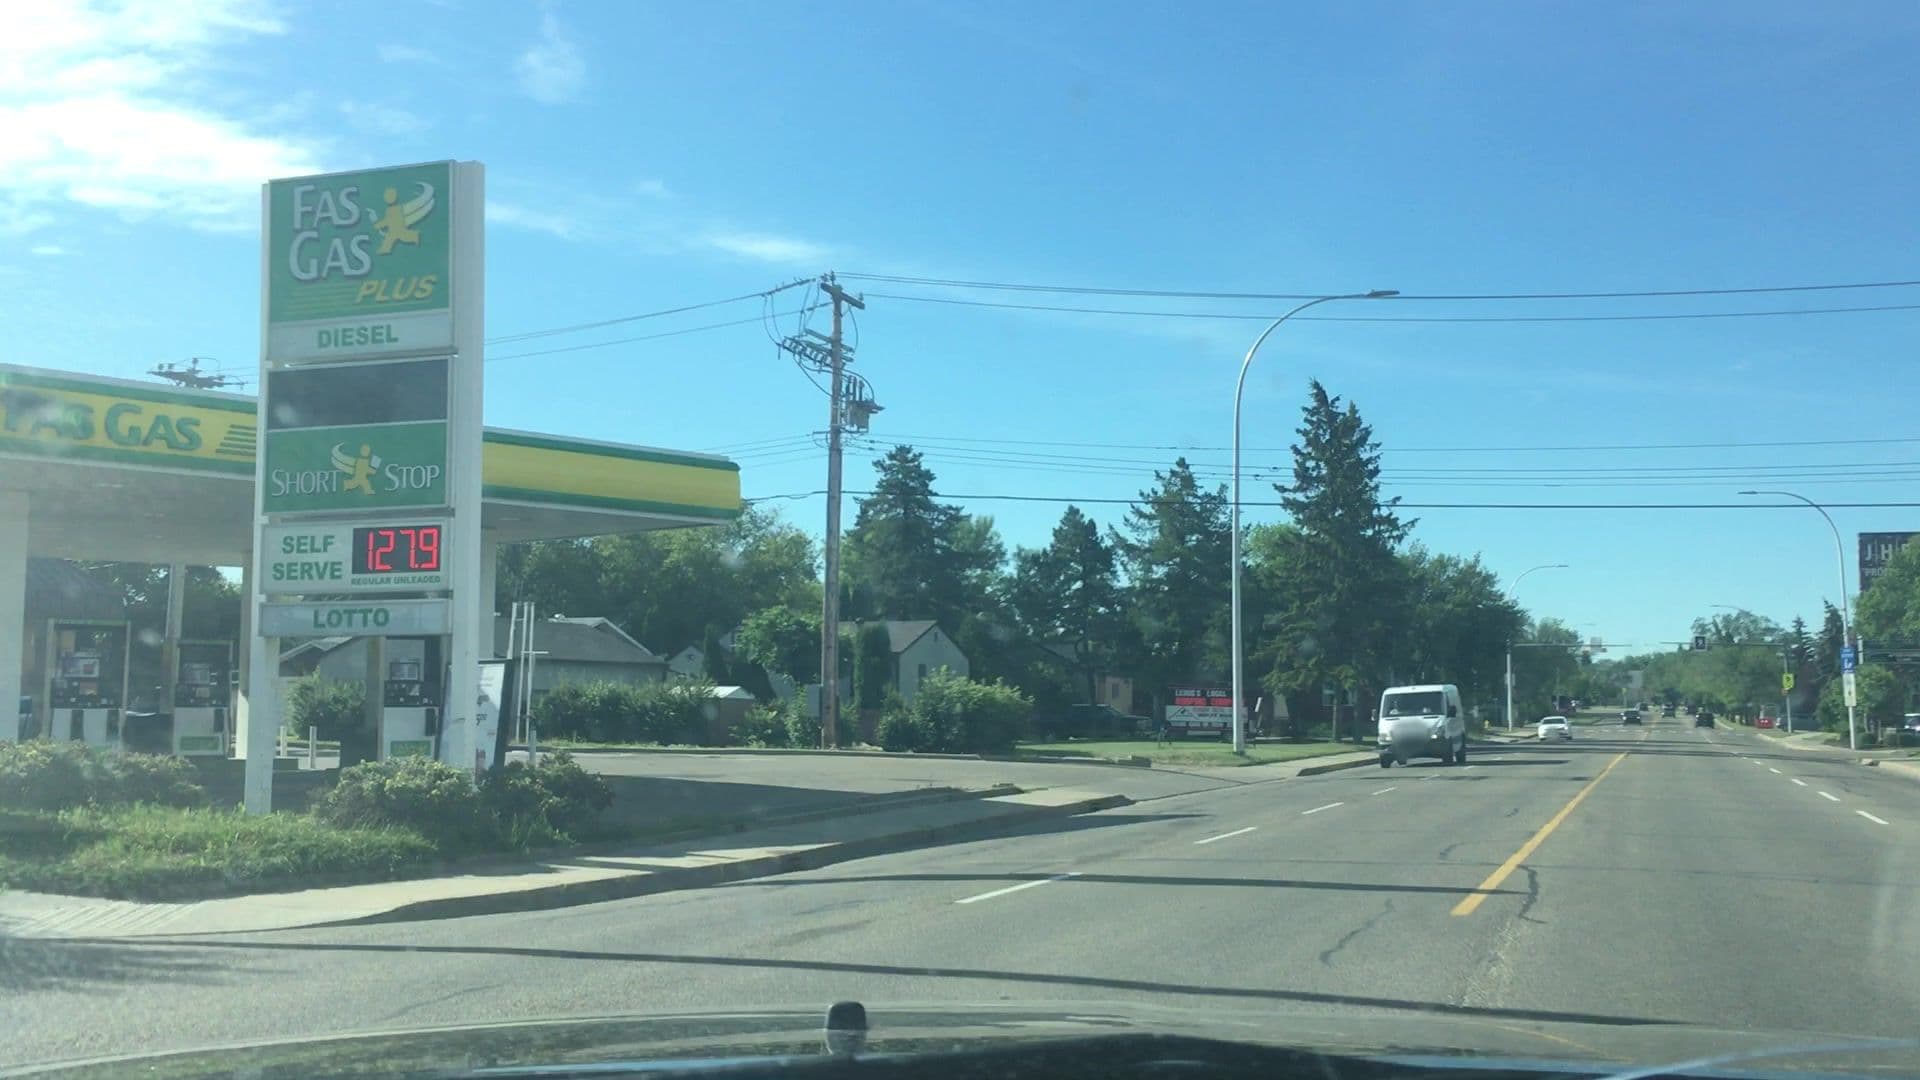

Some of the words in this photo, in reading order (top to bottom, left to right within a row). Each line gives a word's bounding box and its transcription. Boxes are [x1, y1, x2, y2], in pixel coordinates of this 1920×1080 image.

[293, 184, 361, 231] FAS
[288, 230, 372, 281] GAS
[355, 274, 437, 304] PLUS
[317, 324, 399, 349] DIESEL
[104, 402, 204, 451] GAS
[271, 468, 343, 497] SHORT
[384, 463, 441, 491] STOP
[281, 535, 336, 554] SELF
[272, 561, 344, 581] SERVE
[312, 608, 391, 629] LOTTO
